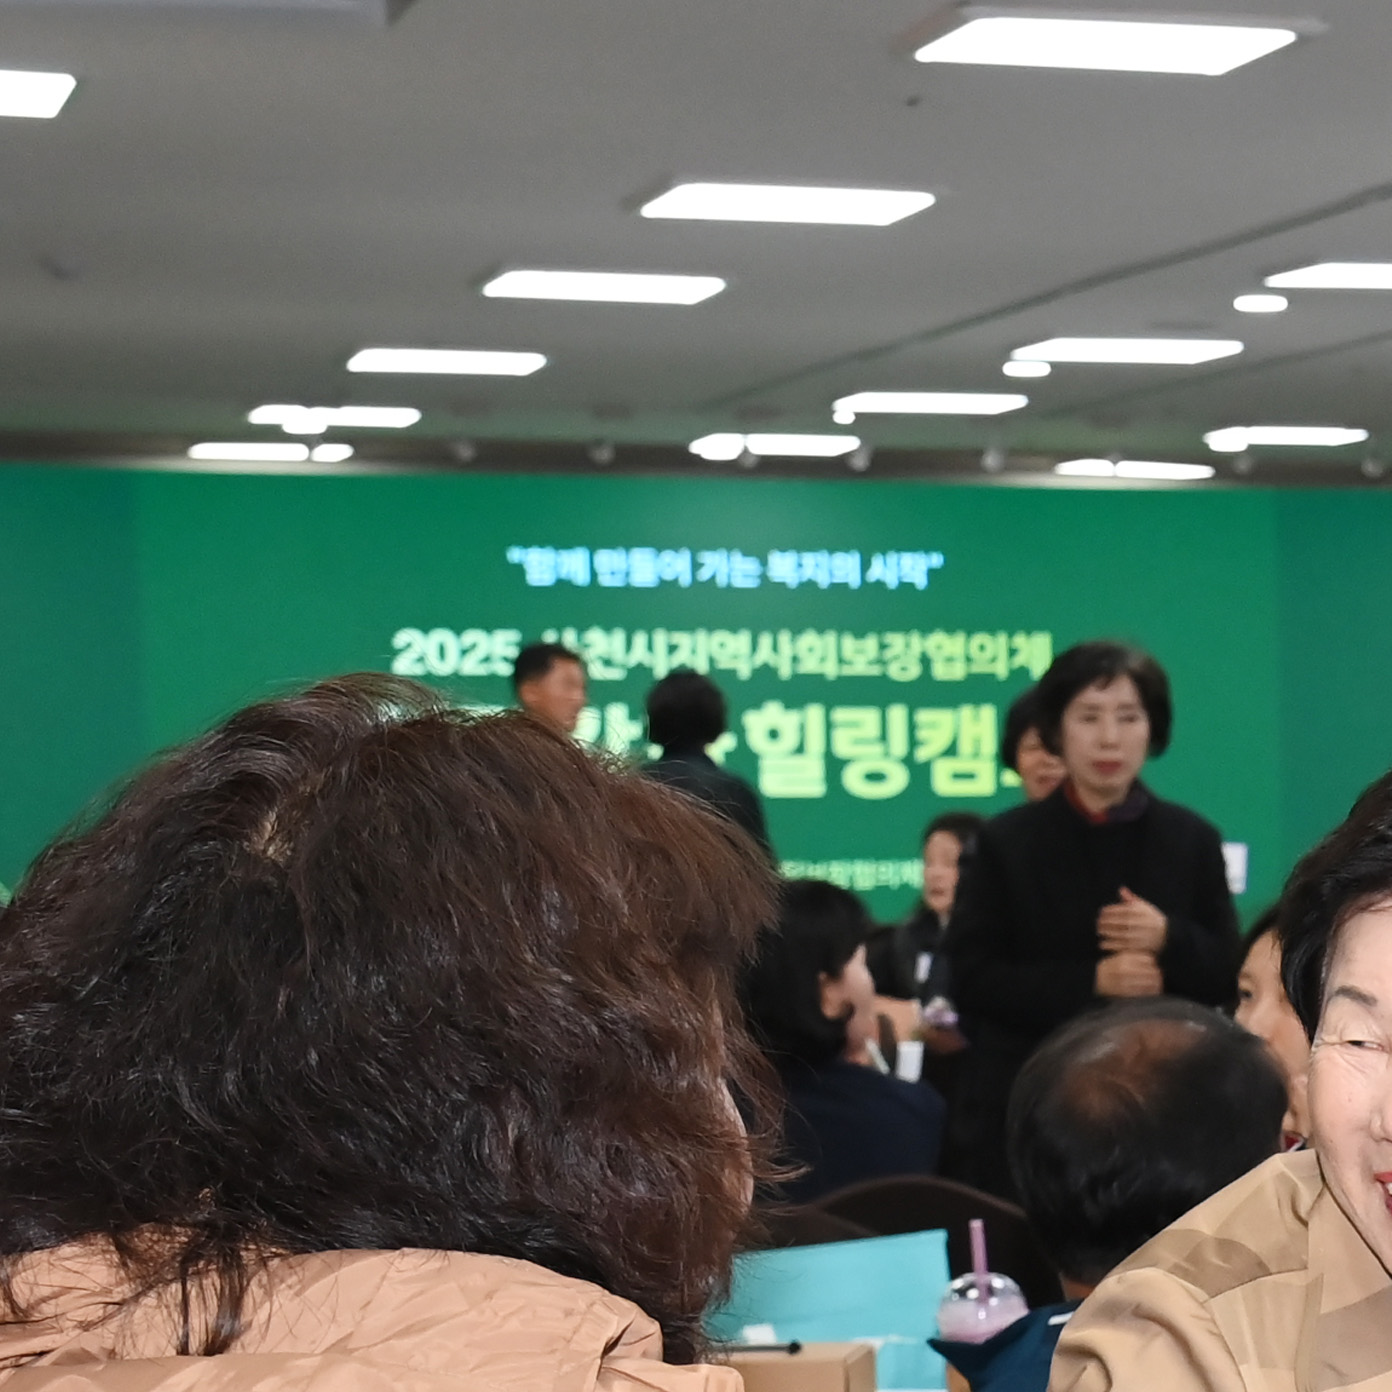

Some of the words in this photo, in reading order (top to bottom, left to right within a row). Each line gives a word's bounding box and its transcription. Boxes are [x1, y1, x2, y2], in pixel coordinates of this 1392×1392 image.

[593, 546, 693, 588] 만들어
[697, 547, 764, 588] 가는
[766, 549, 861, 589] 복지의
